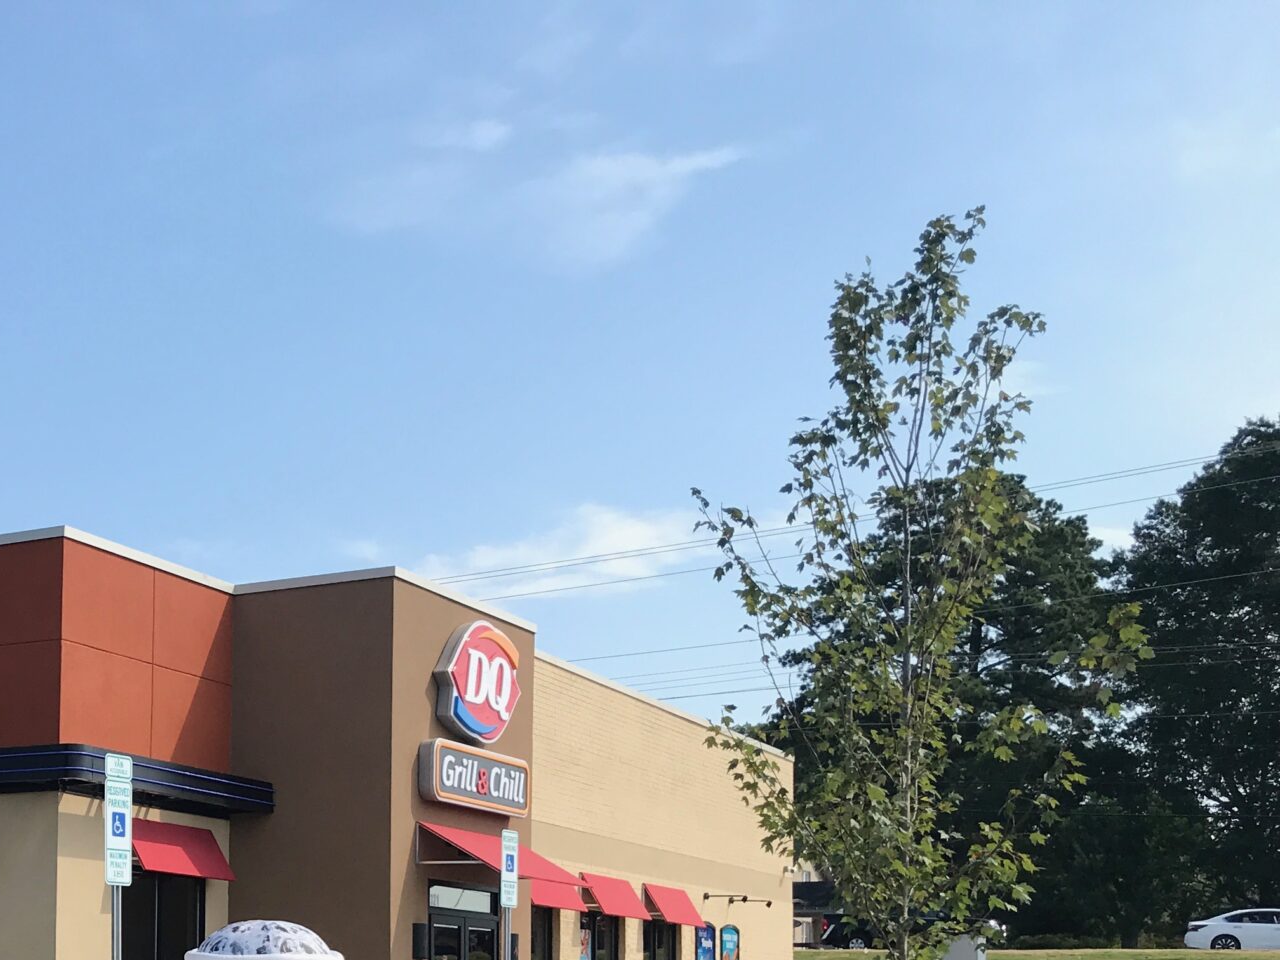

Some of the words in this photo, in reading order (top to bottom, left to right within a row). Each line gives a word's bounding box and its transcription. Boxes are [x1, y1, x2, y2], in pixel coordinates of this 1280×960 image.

[464, 647, 511, 721] DQ
[108, 798, 129, 809] PARKING
[442, 755, 478, 793] Grill
[489, 766, 525, 804] Chill
